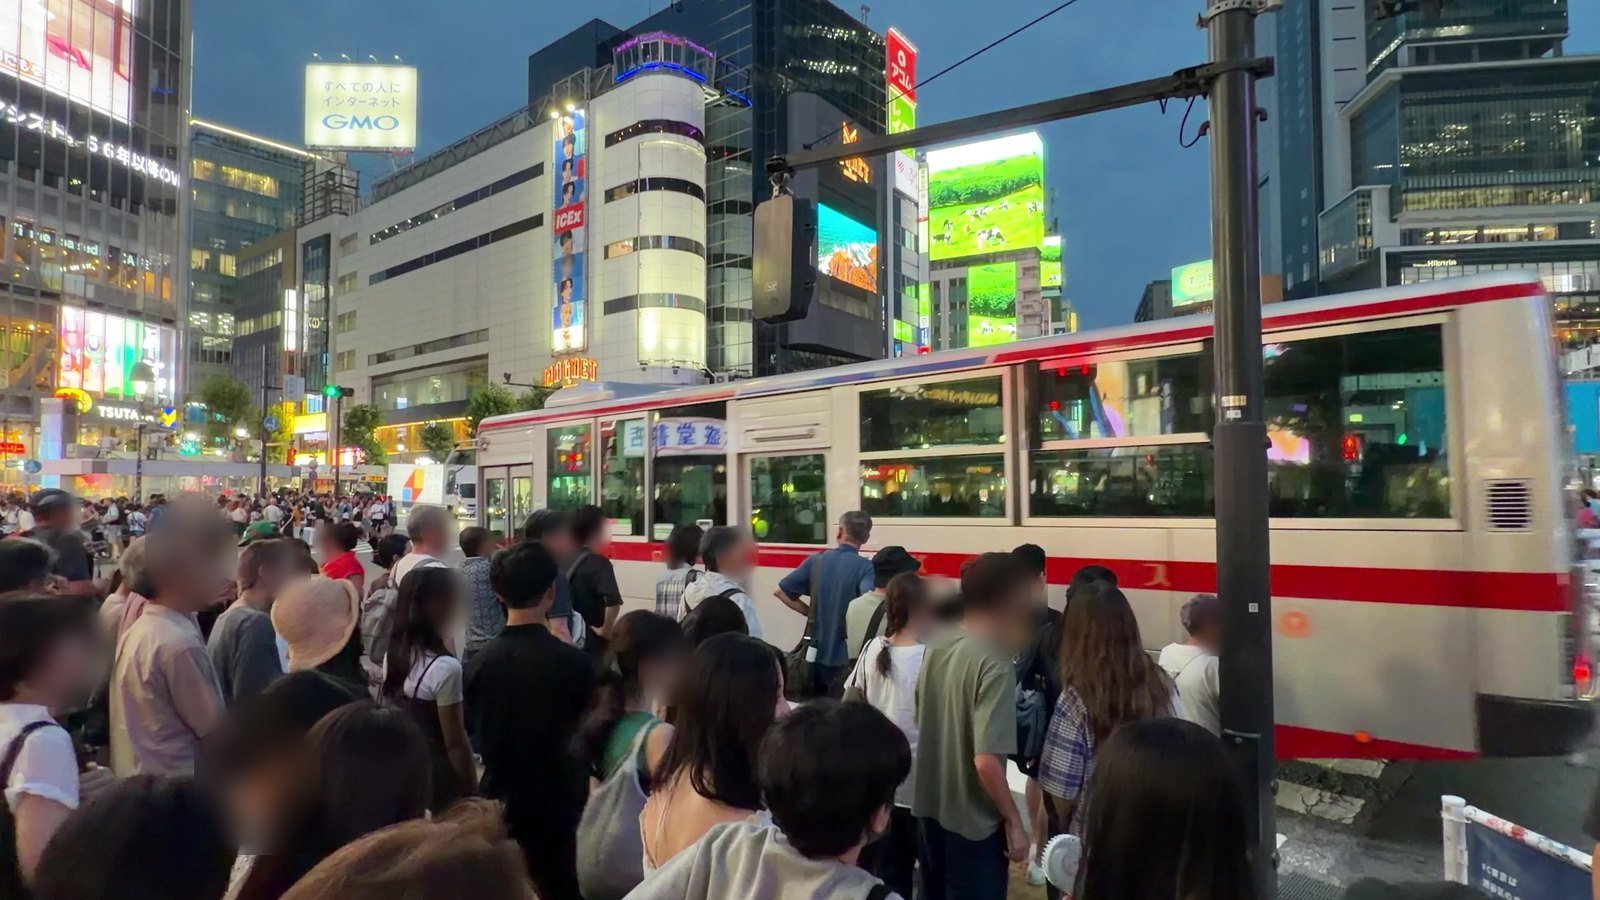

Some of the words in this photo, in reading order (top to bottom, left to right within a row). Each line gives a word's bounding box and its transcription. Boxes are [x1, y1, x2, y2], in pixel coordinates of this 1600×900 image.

[323, 80, 401, 93] すべての人に
[323, 96, 400, 108] インターネット
[322, 113, 400, 131] GMO
